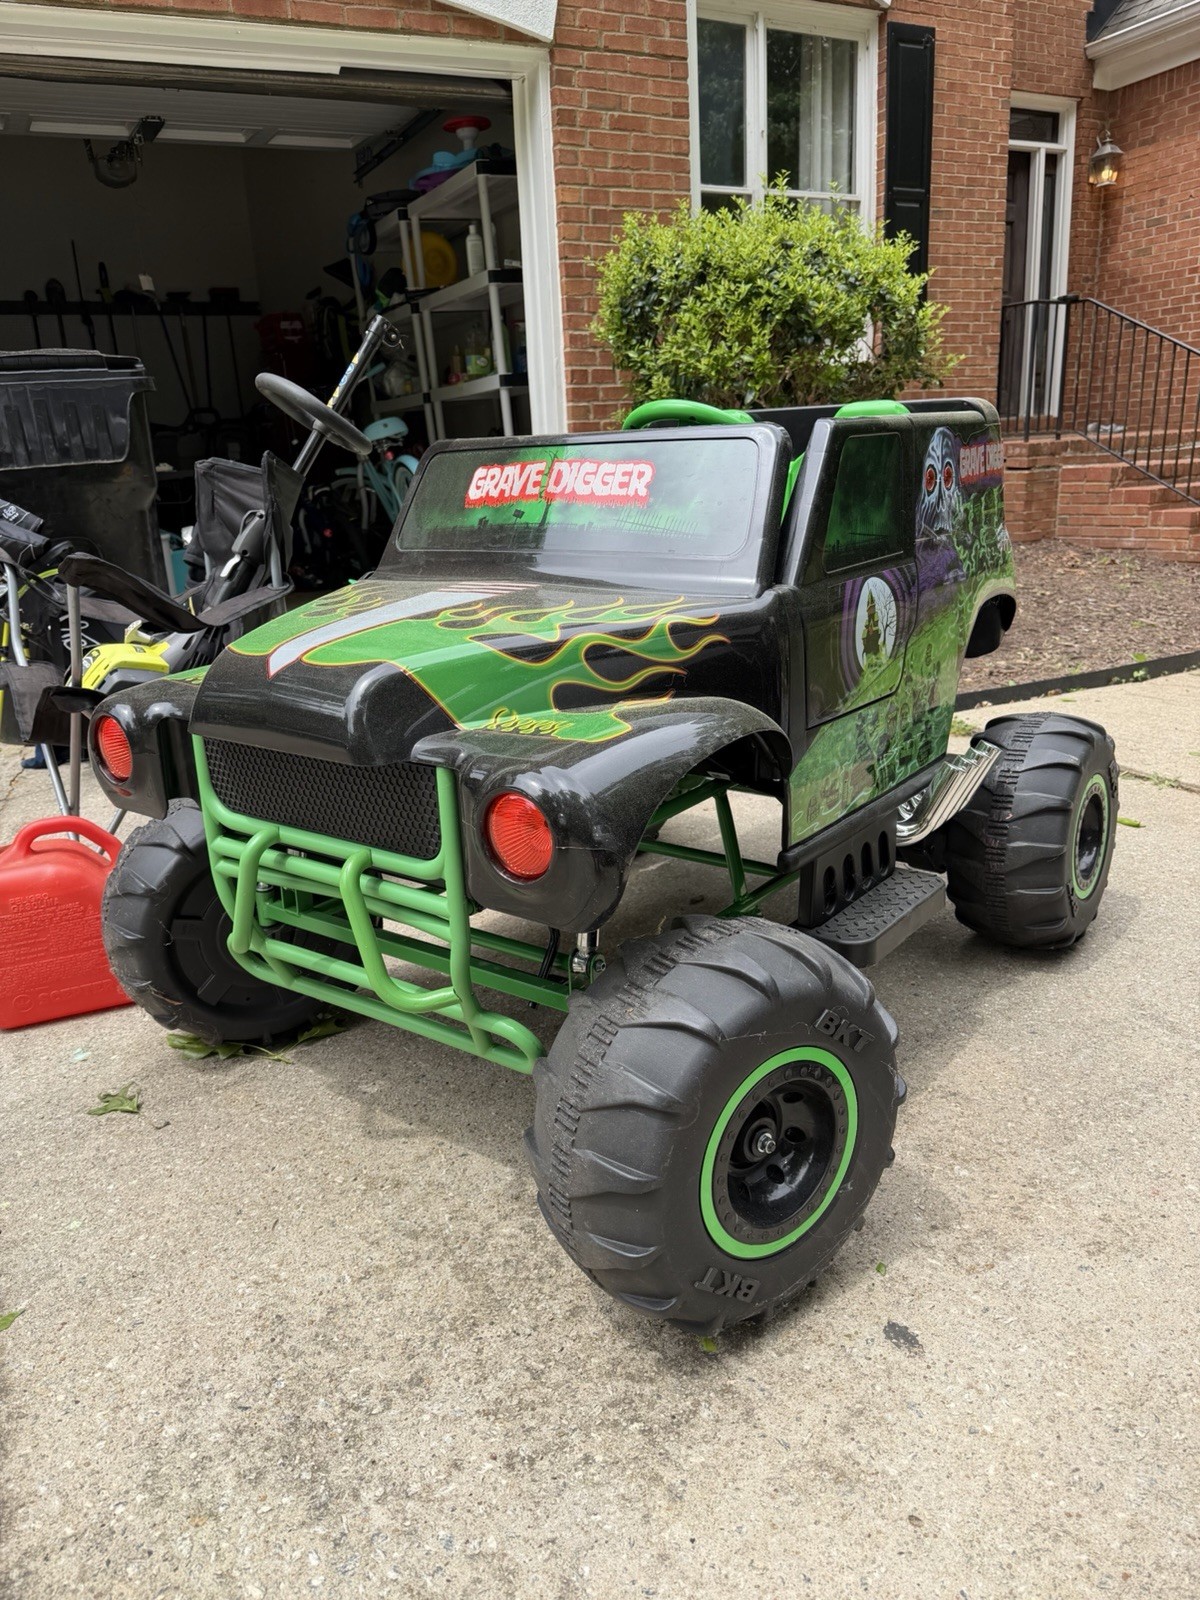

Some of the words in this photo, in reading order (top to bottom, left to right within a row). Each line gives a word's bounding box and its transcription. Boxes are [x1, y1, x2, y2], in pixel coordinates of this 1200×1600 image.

[468, 461, 547, 500] GRAVE
[547, 461, 653, 497] DIGGER
[959, 444, 985, 479] GRAVE
[814, 1009, 876, 1053] BKT
[693, 1266, 761, 1303] BKT
